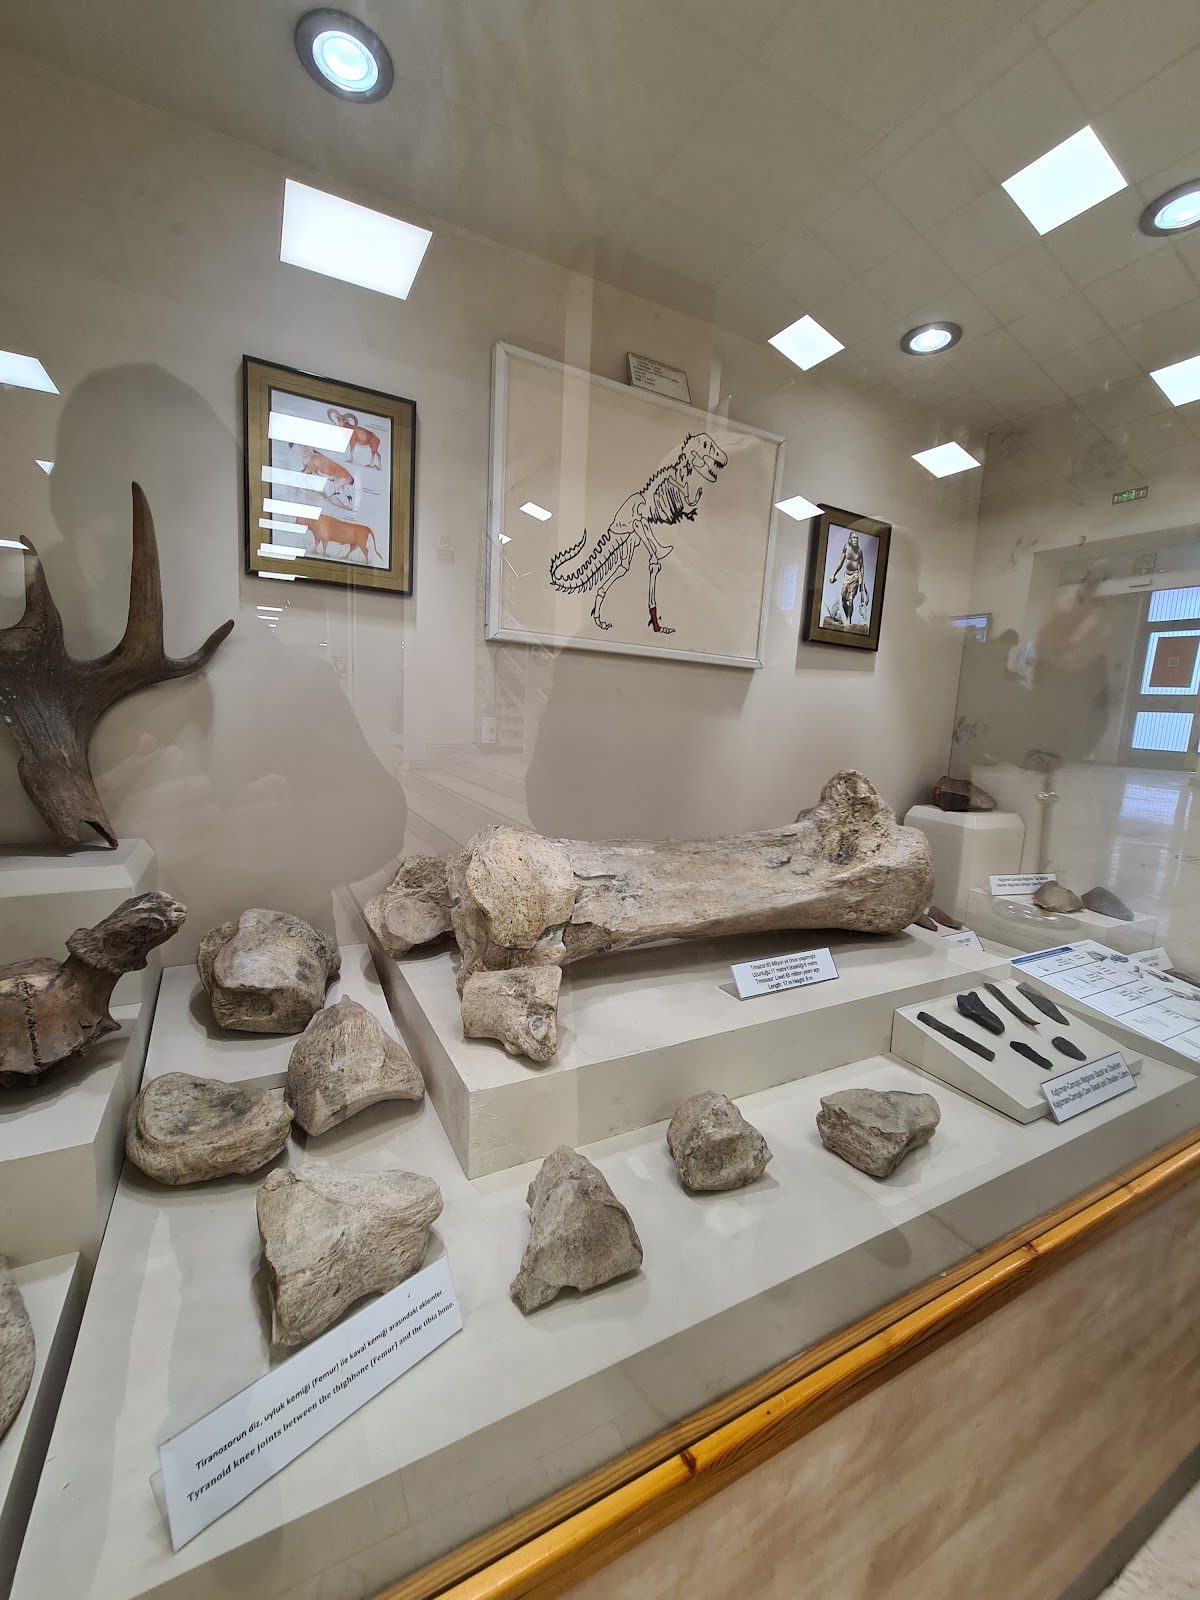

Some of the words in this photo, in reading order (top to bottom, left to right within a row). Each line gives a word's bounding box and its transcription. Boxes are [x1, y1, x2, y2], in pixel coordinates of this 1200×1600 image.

[187, 1465, 231, 1502] Tyranoid
[233, 1449, 256, 1469] knee
[257, 1430, 282, 1453] joints
[283, 1403, 318, 1431] between
[318, 1392, 331, 1405] the
[332, 1364, 369, 1395] thighbone
[370, 1342, 398, 1368] (Femur)
[399, 1332, 411, 1345] and
[412, 1324, 422, 1336] the
[423, 1313, 437, 1327] tibia
[438, 1302, 455, 1317] bone.
[264, 1402, 285, 1422] uyluk
[286, 1383, 311, 1405] kemiği
[312, 1363, 339, 1387] (Femur)
[349, 1343, 367, 1359] kaval
[367, 1328, 388, 1347] kemiği
[389, 1307, 418, 1331] arasındaki
